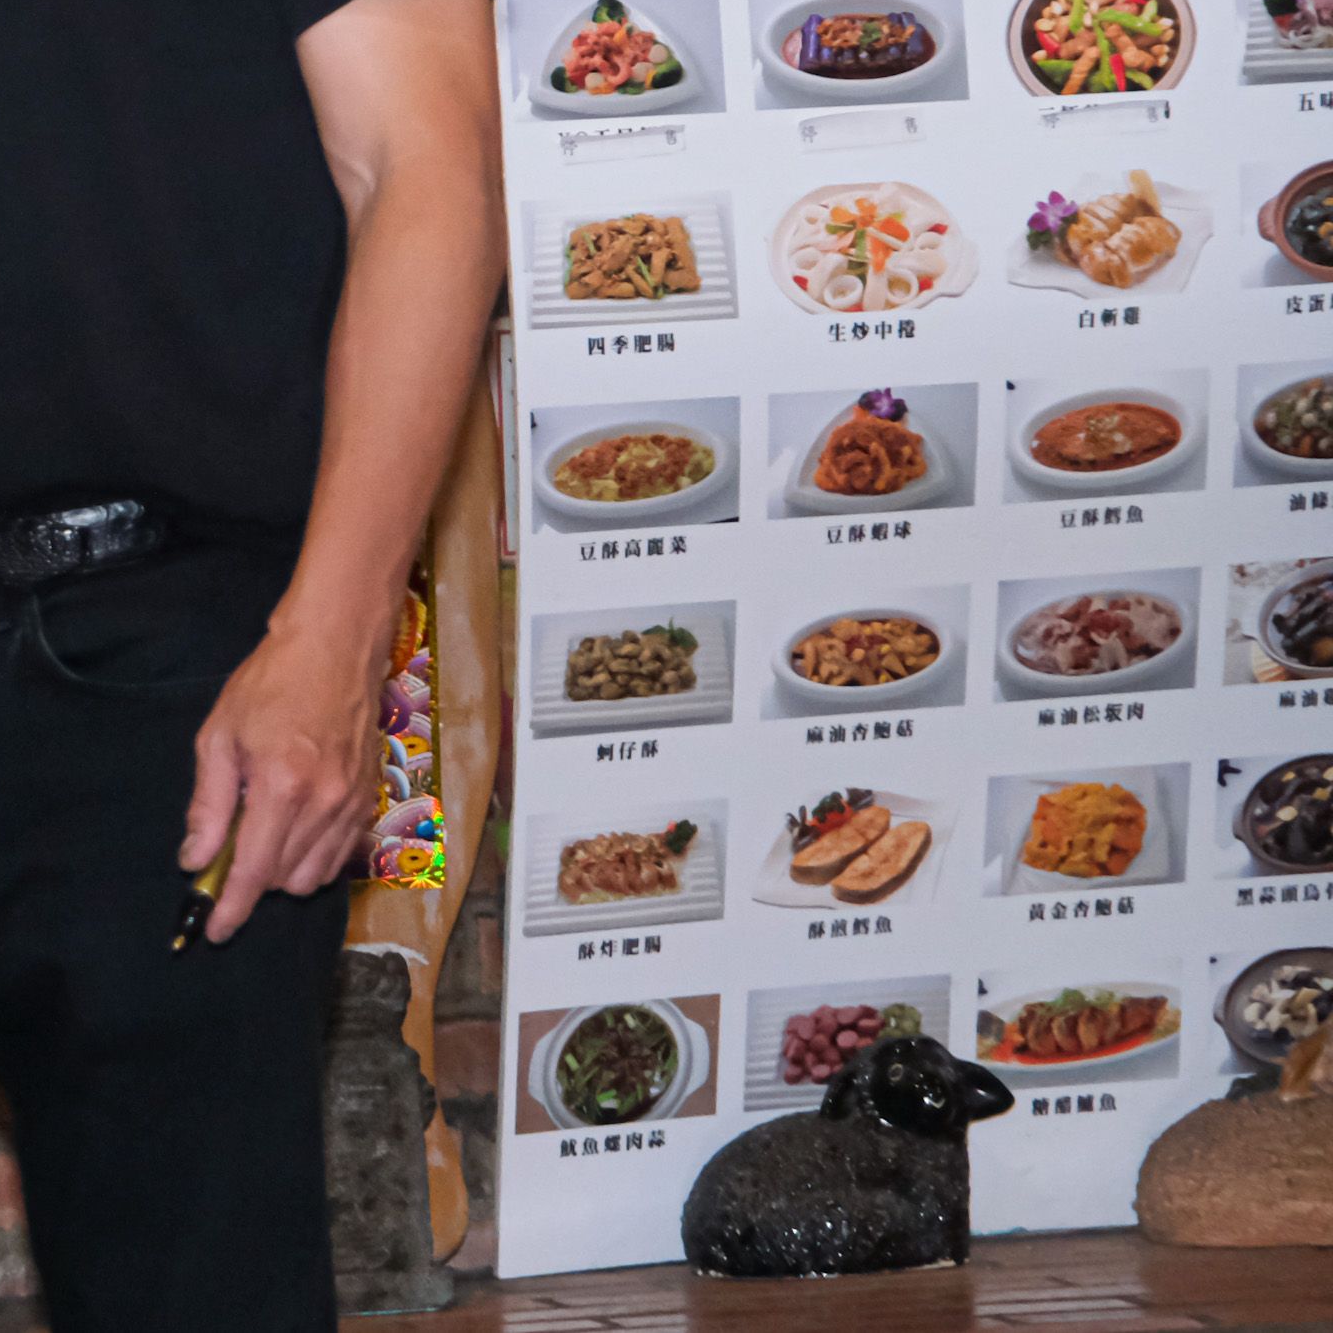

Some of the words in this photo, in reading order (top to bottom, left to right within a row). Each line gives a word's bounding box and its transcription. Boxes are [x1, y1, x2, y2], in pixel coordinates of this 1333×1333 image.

[588, 333, 675, 355] 四季肥腸
[826, 521, 912, 544] 豆酥蝦球
[579, 536, 687, 561] 豆酥高麗菜
[596, 740, 659, 762] 蚵仔酥
[578, 935, 662, 961] 酥炸肥腸
